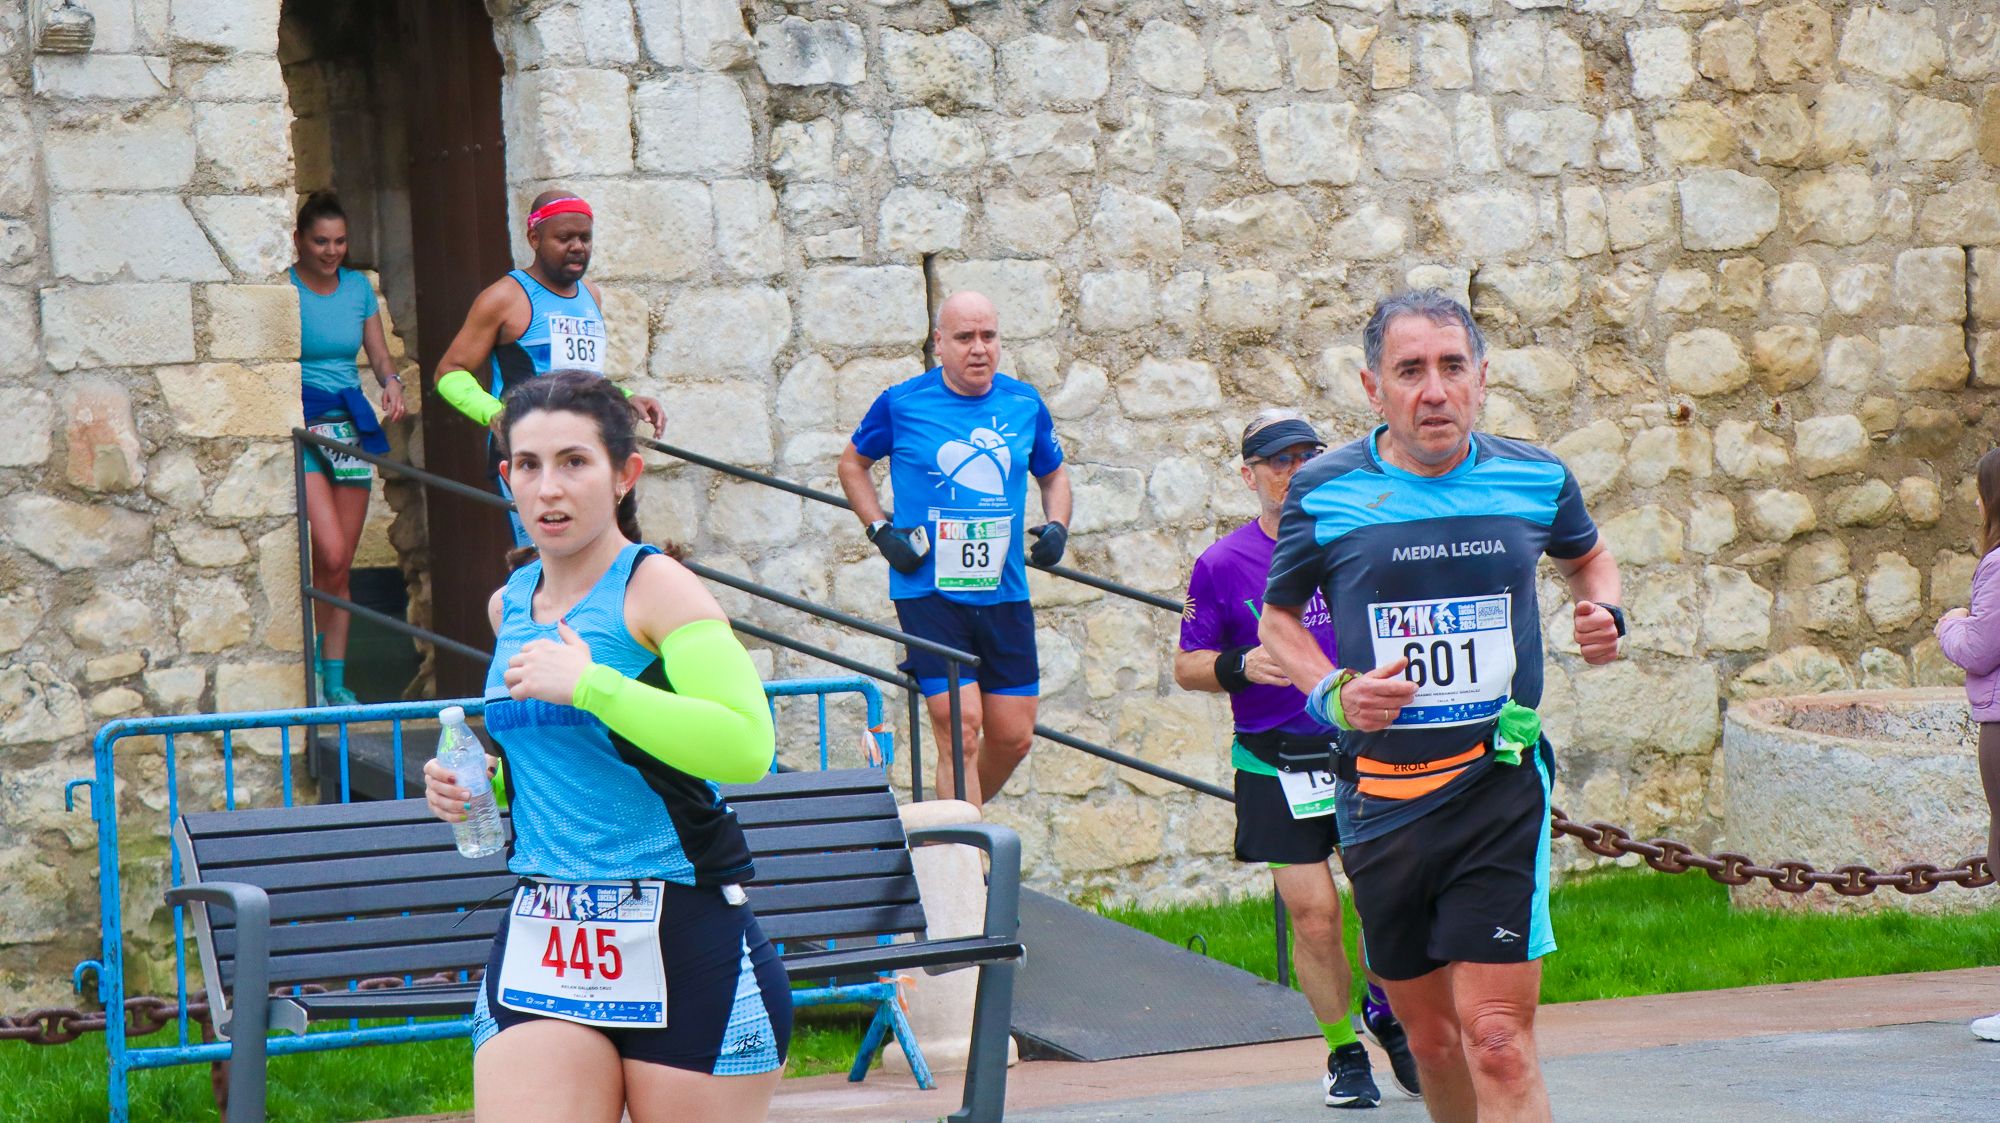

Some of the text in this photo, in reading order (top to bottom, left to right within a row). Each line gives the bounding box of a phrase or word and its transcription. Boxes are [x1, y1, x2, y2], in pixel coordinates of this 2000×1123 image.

[565, 337, 596, 362] 363
[962, 541, 990, 568] 63
[1392, 539, 1506, 561] MEDIA LEGUA
[1390, 605, 1434, 636] 21K
[1404, 637, 1478, 688] 601
[530, 884, 571, 919] 21K
[541, 925, 623, 980] 445
